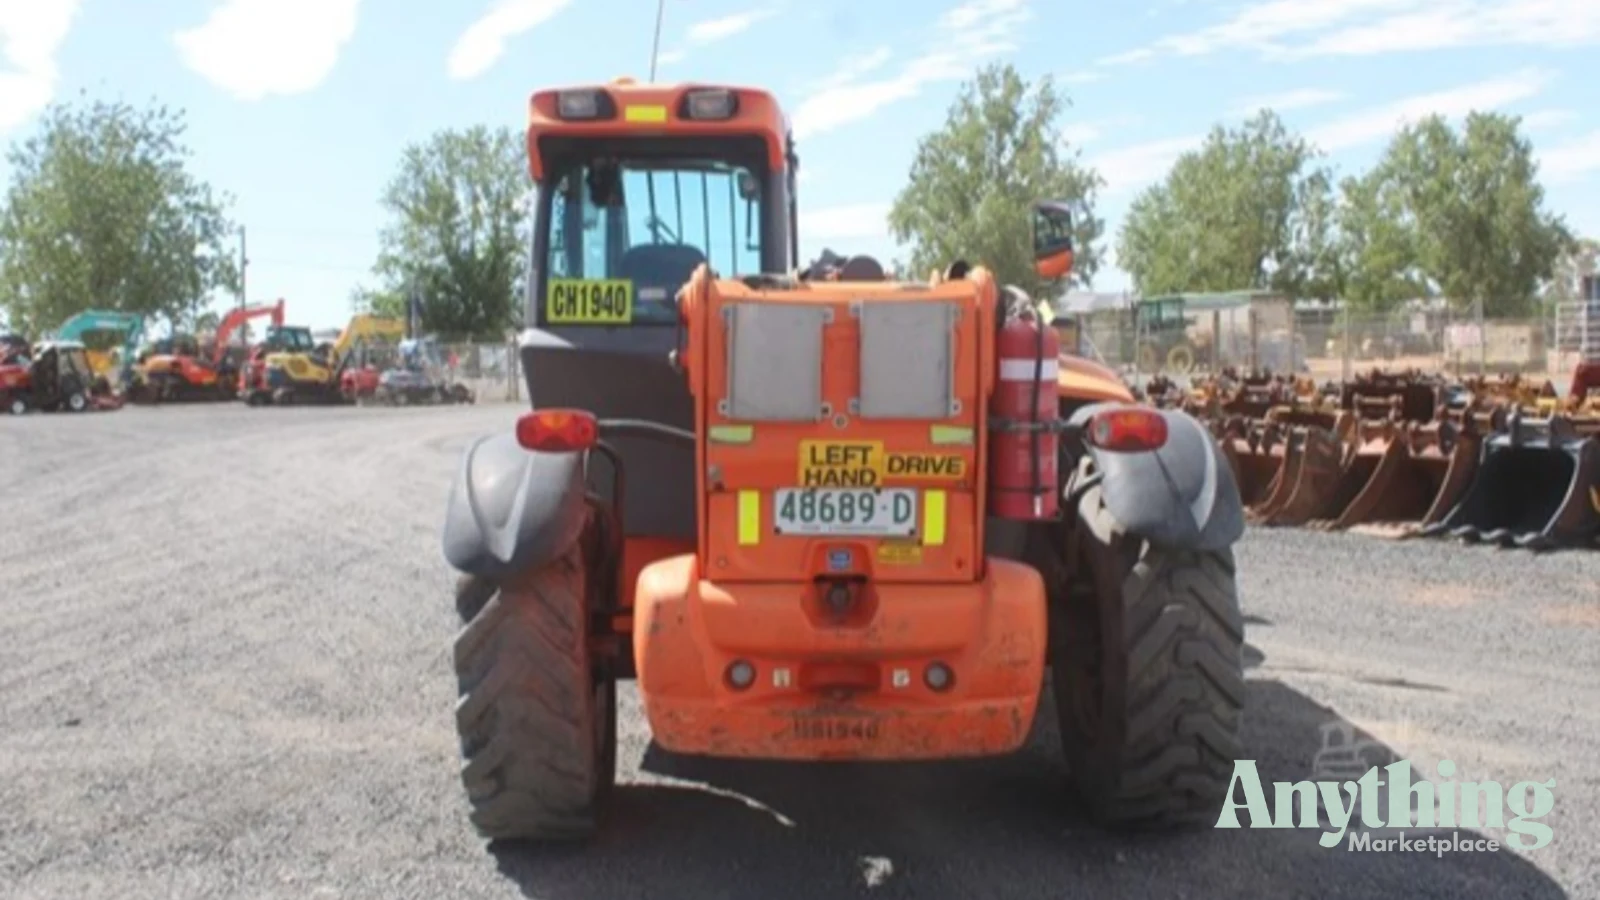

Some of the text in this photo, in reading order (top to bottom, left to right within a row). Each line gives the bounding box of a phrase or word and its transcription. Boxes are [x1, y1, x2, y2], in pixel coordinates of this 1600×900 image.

[553, 284, 626, 317] CH1940
[809, 444, 873, 466] LEFT
[887, 455, 962, 475] DRIVE
[804, 467, 877, 487] HAND
